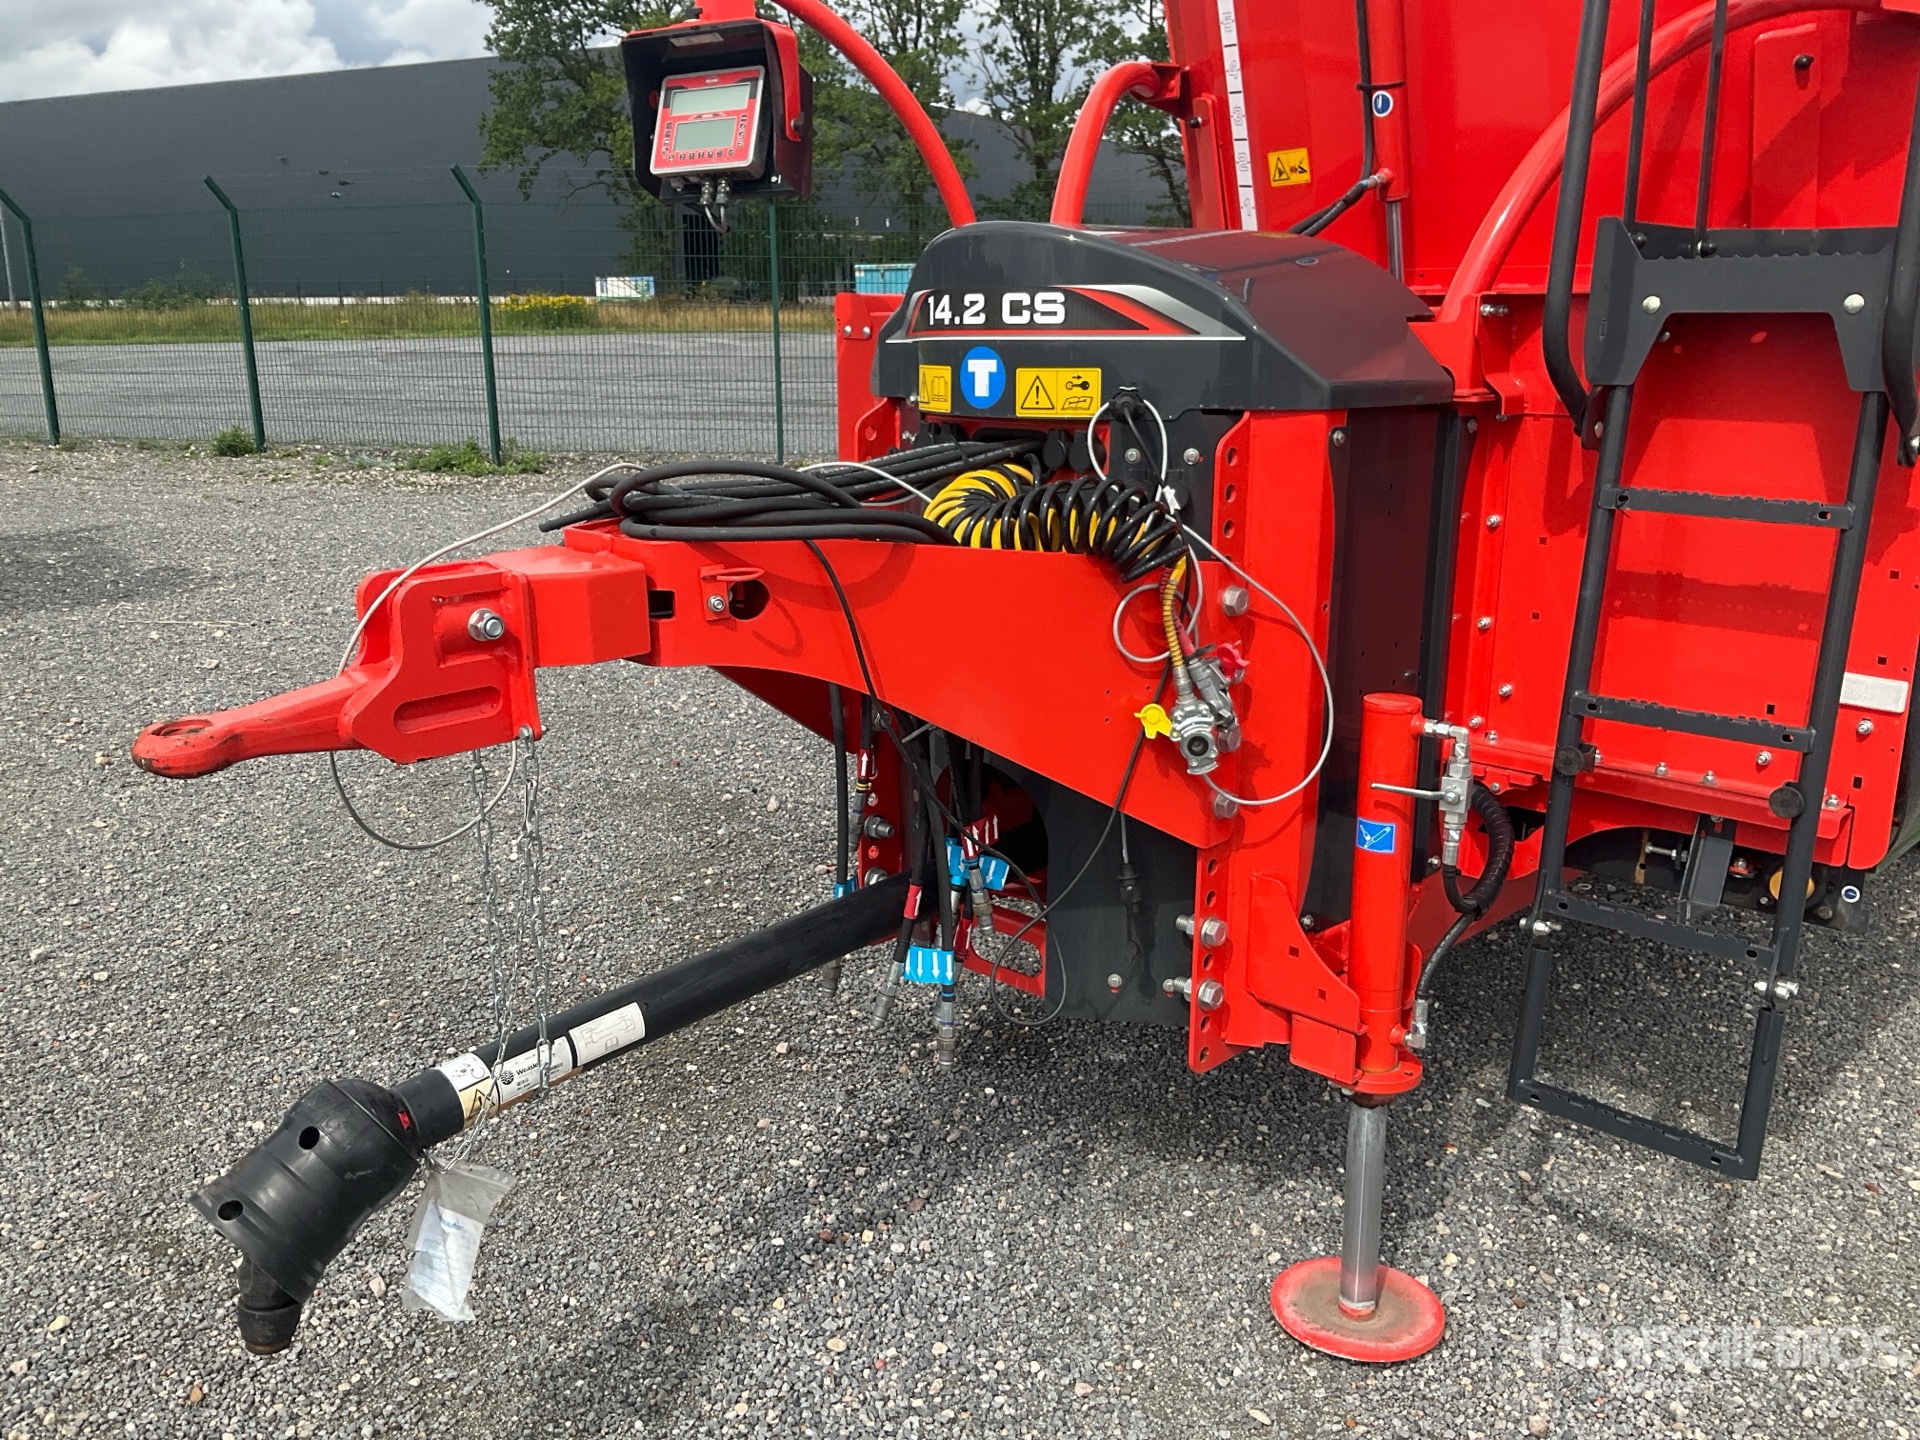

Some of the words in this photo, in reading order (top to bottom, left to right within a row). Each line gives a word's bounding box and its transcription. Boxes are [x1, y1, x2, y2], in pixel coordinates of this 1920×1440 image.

[1232, 106, 1244, 127] 3
[1237, 152, 1249, 172] 2
[927, 293, 986, 326] 14.2
[1001, 291, 1066, 325] CS
[967, 359, 997, 397] T
[515, 1061, 542, 1077] Weasle
